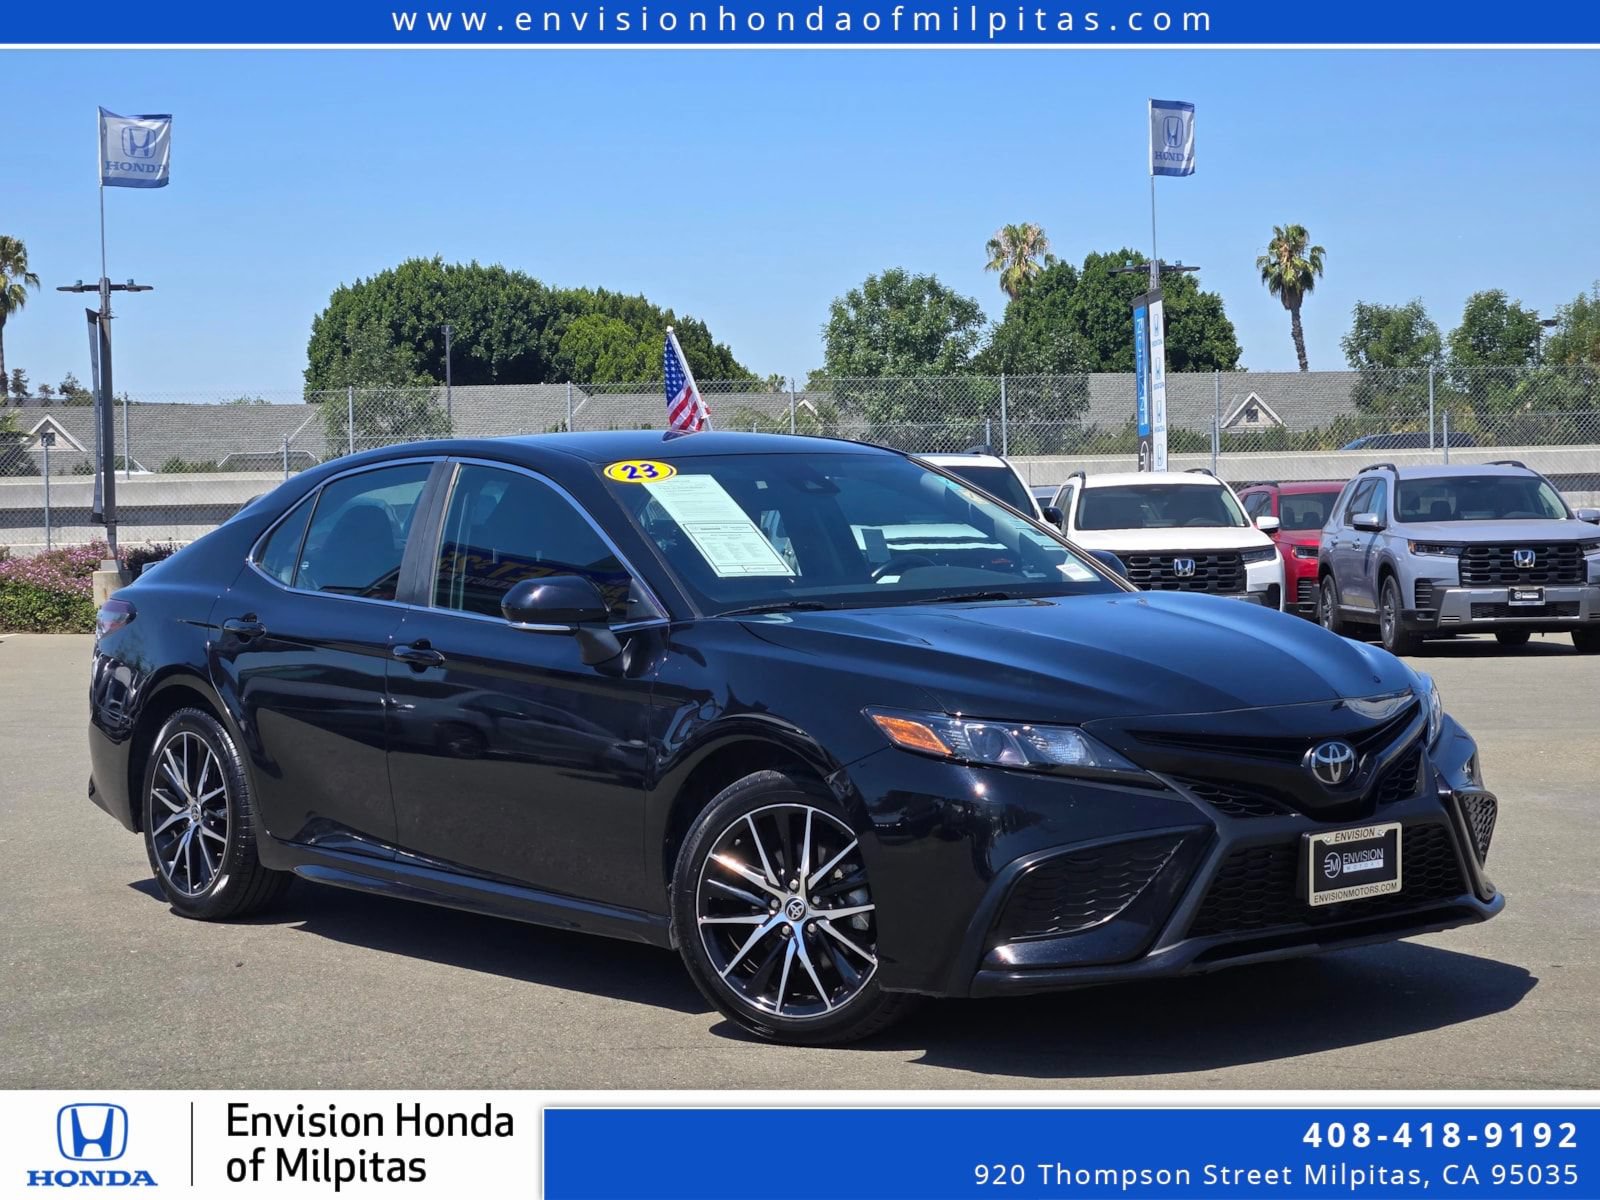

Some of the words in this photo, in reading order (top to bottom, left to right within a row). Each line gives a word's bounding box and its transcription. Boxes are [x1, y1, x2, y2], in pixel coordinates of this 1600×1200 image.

[621, 463, 659, 479] 23
[1335, 827, 1375, 842] ENVISION
[1343, 847, 1384, 865] ENVISION
[1314, 881, 1398, 904] ENVISIONMOTORS.COM
